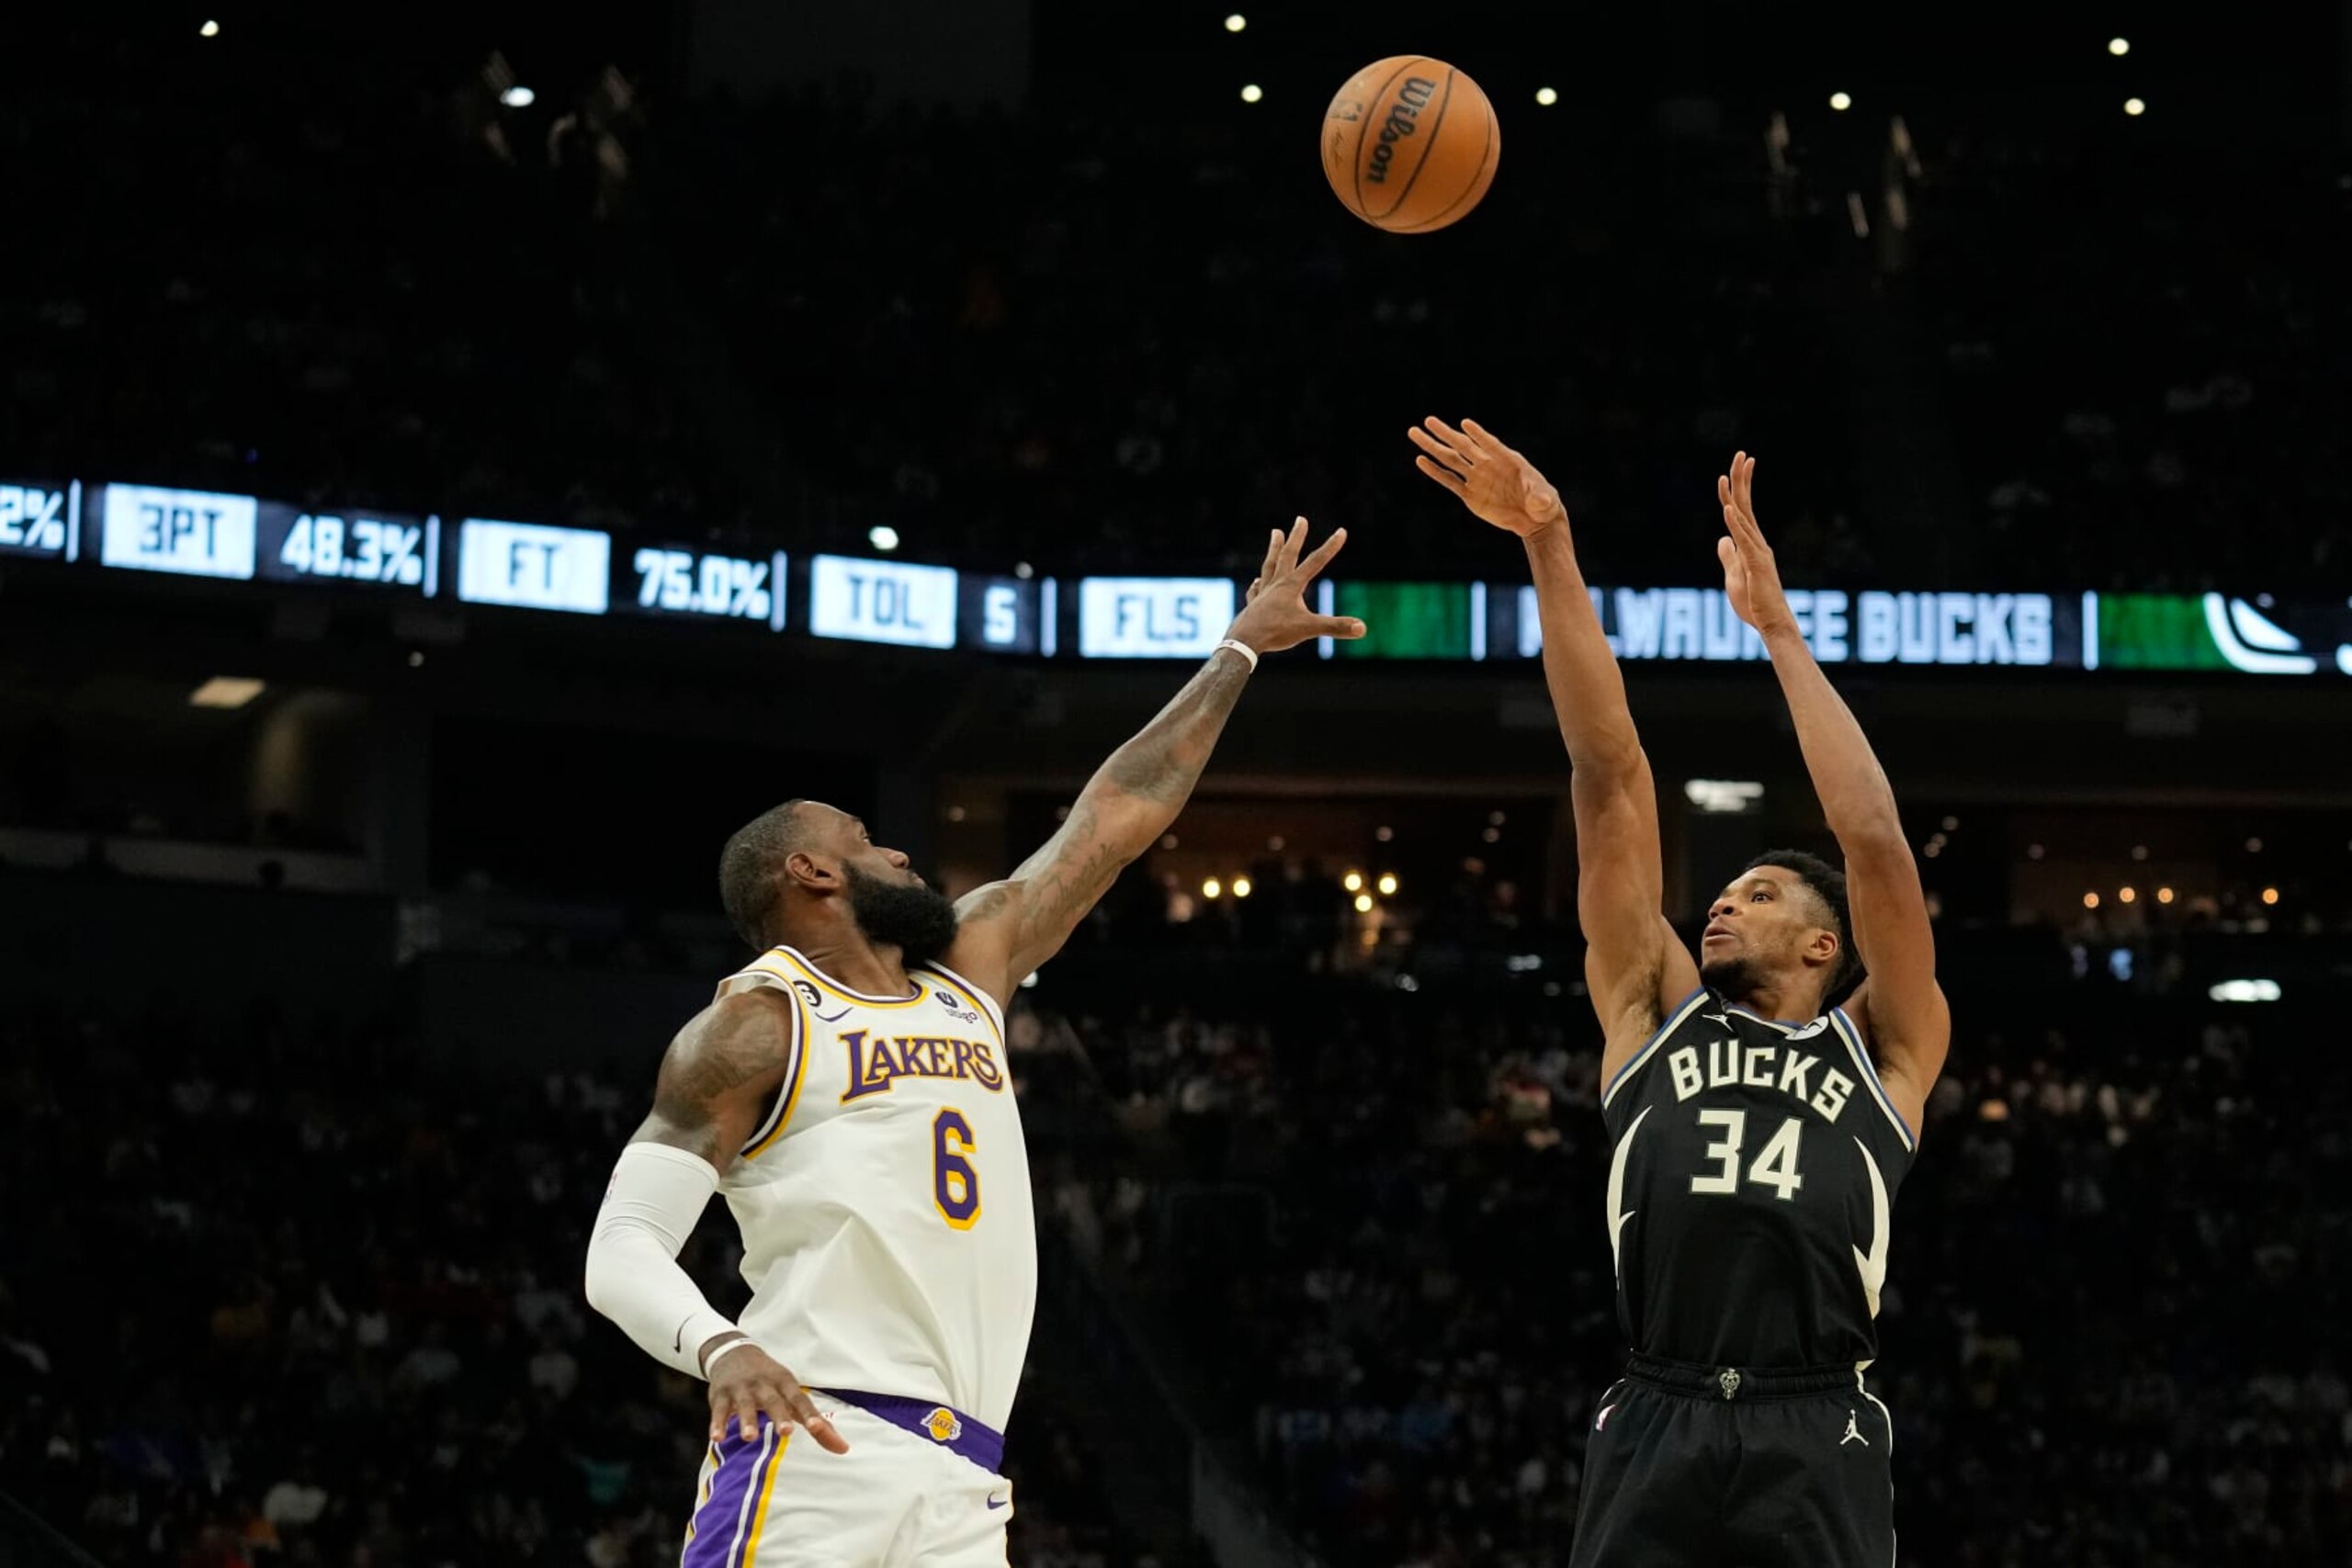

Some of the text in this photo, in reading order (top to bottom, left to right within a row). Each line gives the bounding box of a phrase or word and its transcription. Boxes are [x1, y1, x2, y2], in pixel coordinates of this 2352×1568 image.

[1366, 76, 1437, 183] Wilson
[140, 502, 424, 585] 3PT 48.3%
[508, 539, 771, 620] FT 75.0%
[847, 573, 1017, 645] TOL 5
[1116, 593, 1200, 640] FLS
[1858, 591, 2052, 664] BUCKS
[838, 1028, 1004, 1106] LAKERS
[1668, 1039, 1856, 1123] BUCKS
[932, 1106, 982, 1231] 6
[1690, 1108, 1804, 1201] 34
